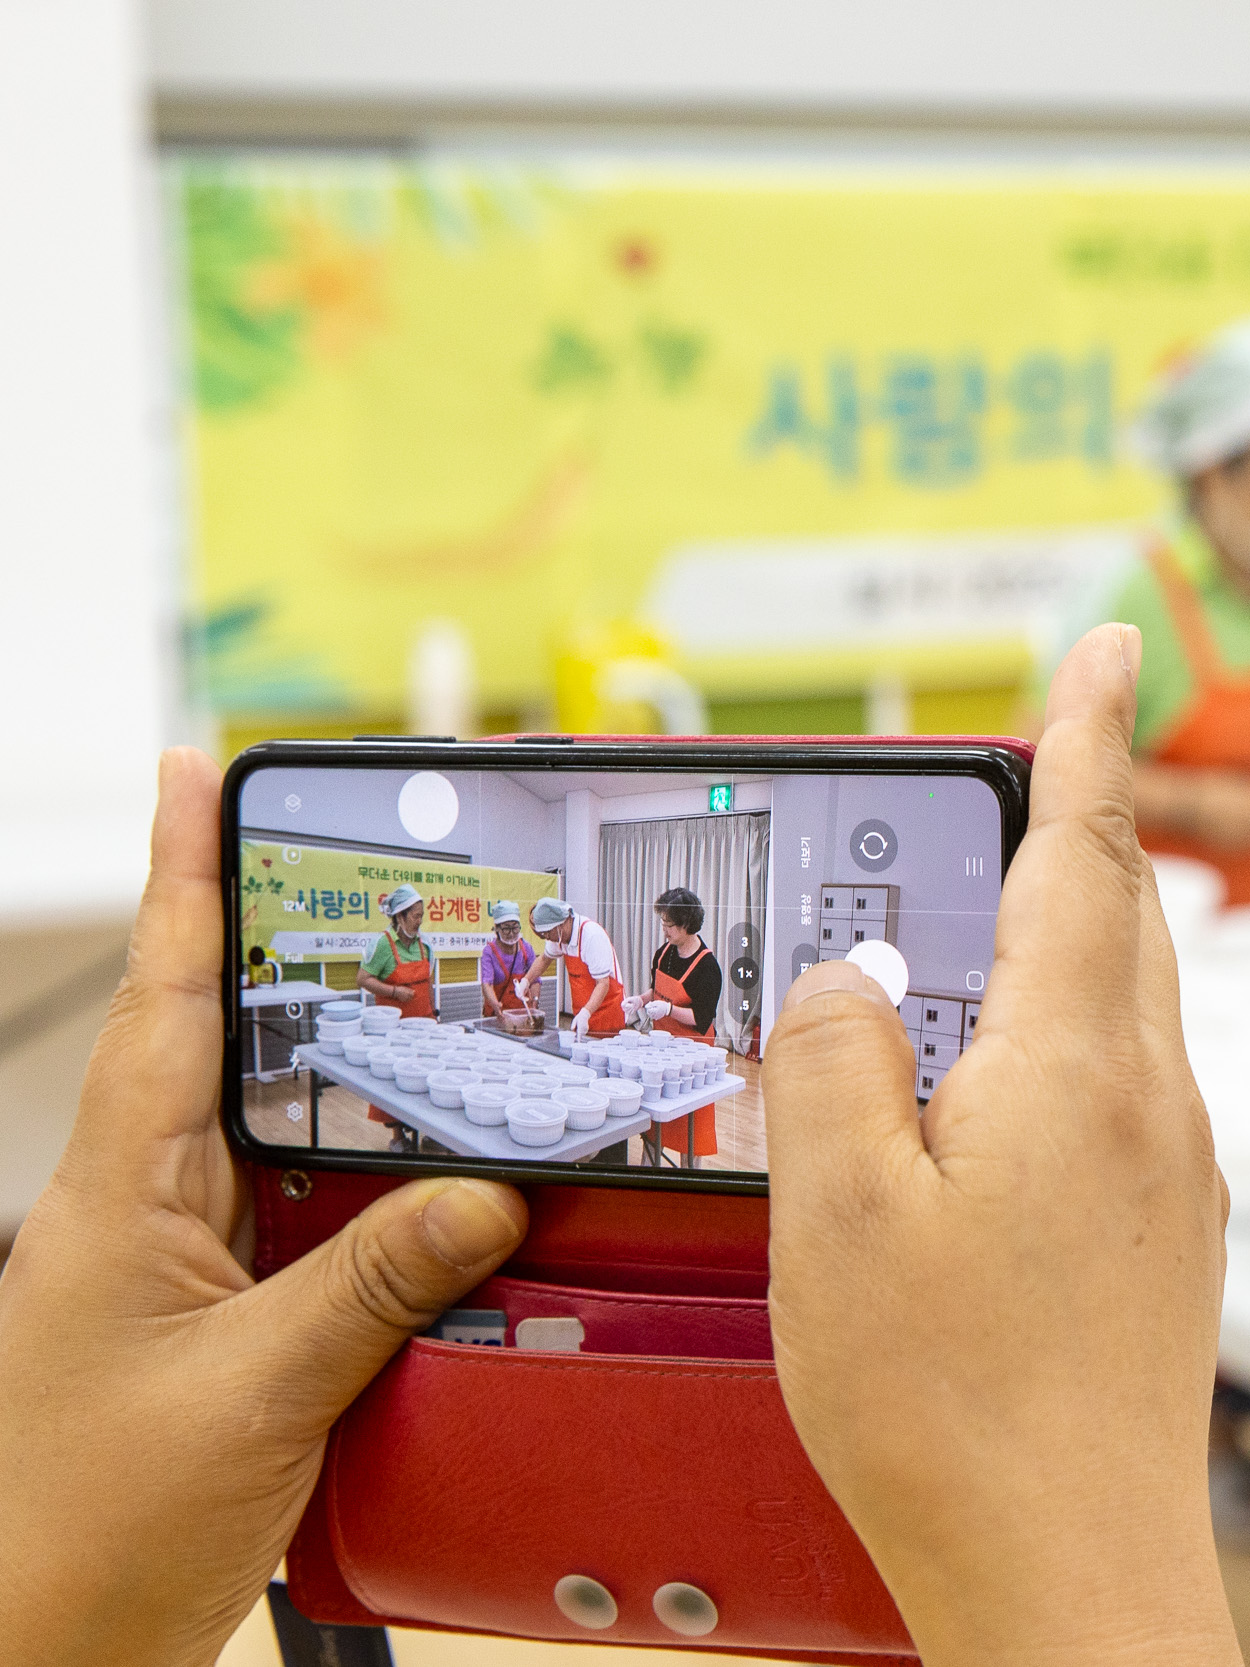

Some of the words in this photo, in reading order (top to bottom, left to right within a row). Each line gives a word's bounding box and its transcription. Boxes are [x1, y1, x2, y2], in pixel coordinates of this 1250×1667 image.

[745, 345, 1115, 489] 사랑의
[801, 836, 811, 868] 더보기
[358, 866, 390, 881] 무더운
[393, 869, 423, 883] 더위를
[425, 872, 444, 884] 함께
[283, 900, 306, 912] 12M
[295, 888, 370, 920] 사랑의
[427, 896, 481, 922] 삼계탕
[801, 893, 812, 926] 동영상
[741, 937, 749, 948] 3
